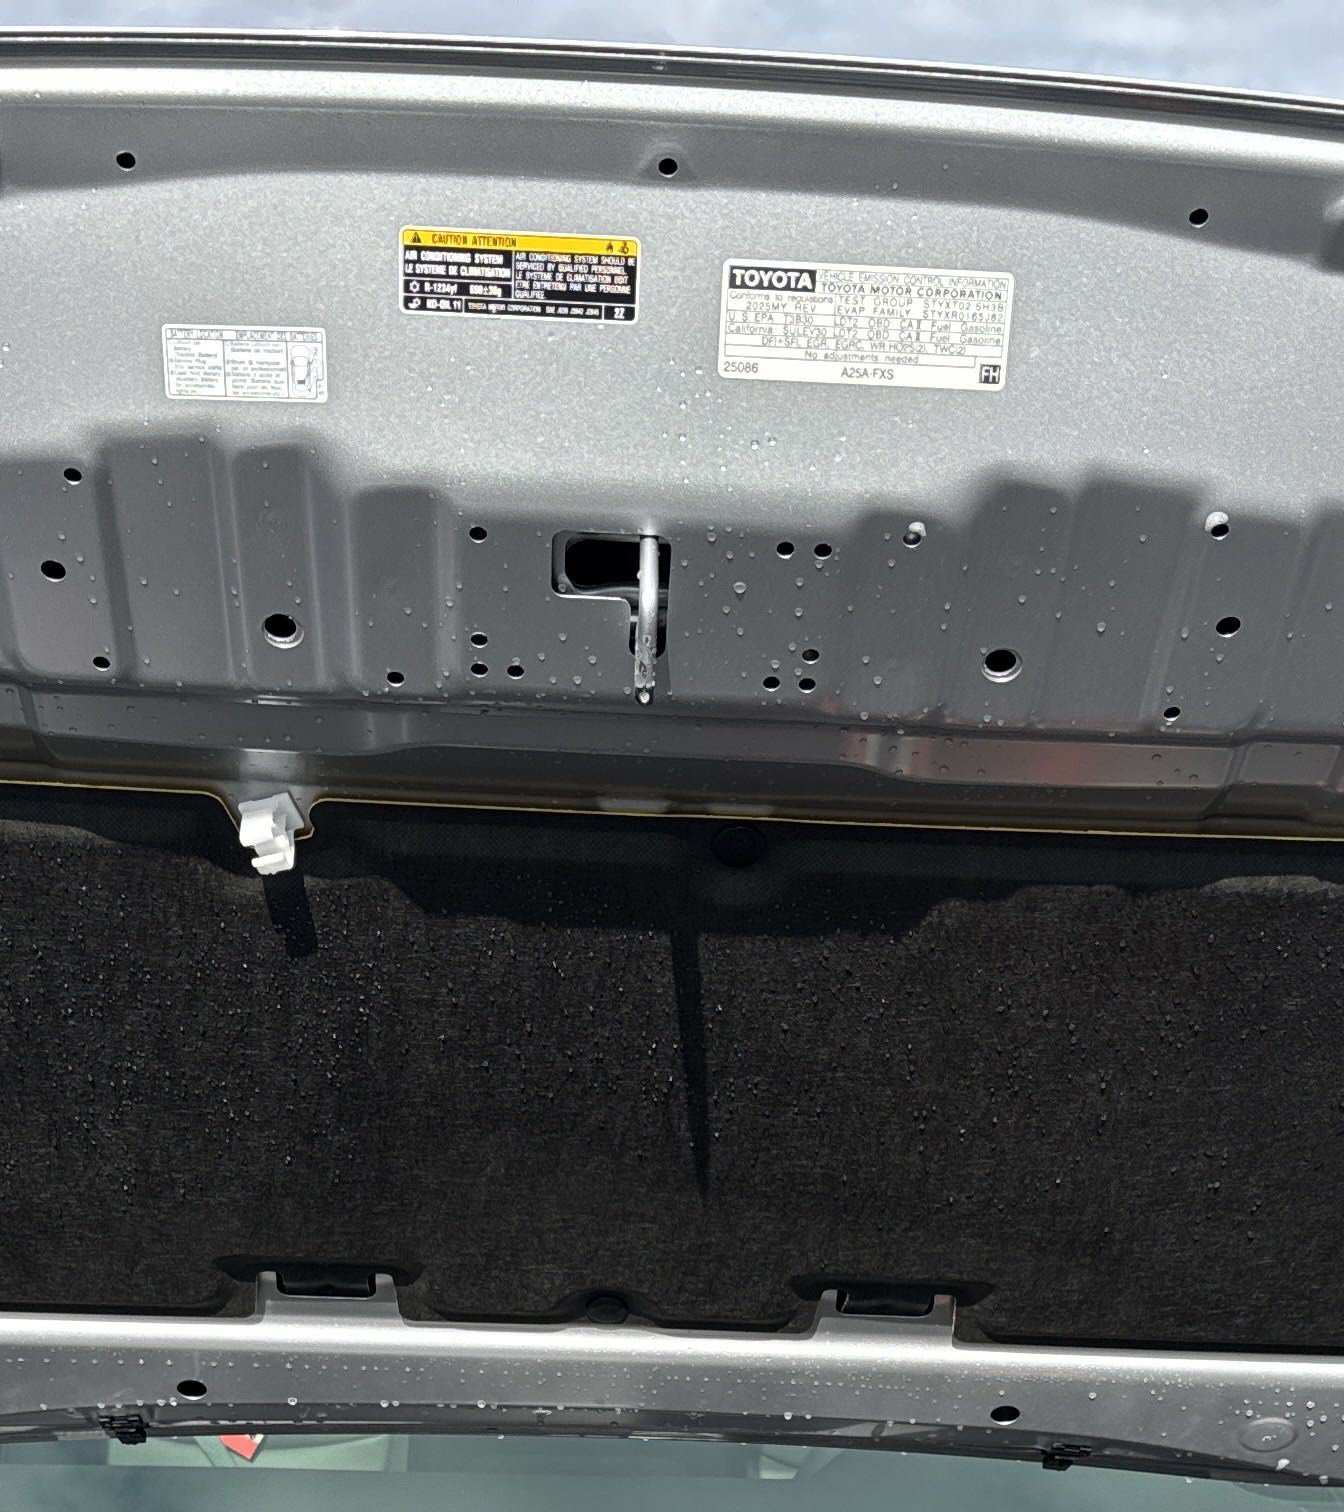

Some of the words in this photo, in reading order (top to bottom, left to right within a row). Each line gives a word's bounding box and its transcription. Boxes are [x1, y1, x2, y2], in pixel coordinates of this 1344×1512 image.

[432, 233, 467, 245] CAUTION
[472, 235, 516, 248] ATTENTION
[733, 269, 813, 290] TOYOTA
[819, 271, 854, 282] VEHICLE
[859, 272, 899, 284] EMISSION
[904, 275, 943, 287] CONTROL
[950, 278, 1006, 289] INFORMATION
[822, 282, 866, 293] TOYOTA
[870, 284, 912, 296] MOTOR
[917, 287, 1002, 300] CORPORATION
[746, 301, 787, 312] 2025MY
[839, 295, 865, 305] TEST
[874, 297, 912, 308] GROUP
[837, 306, 865, 316] EVAP
[873, 307, 911, 318] FAMILY
[755, 313, 774, 322] EPA
[868, 318, 890, 329] OBD
[931, 321, 950, 332] Fuel
[961, 322, 1002, 334] Gasoline
[728, 323, 773, 334] California
[931, 333, 949, 344] Fuel
[960, 333, 1001, 345] Gasoline
[805, 350, 818, 359] No
[824, 352, 878, 362] adjustments
[884, 355, 919, 364] needed
[723, 361, 759, 373] 25086
